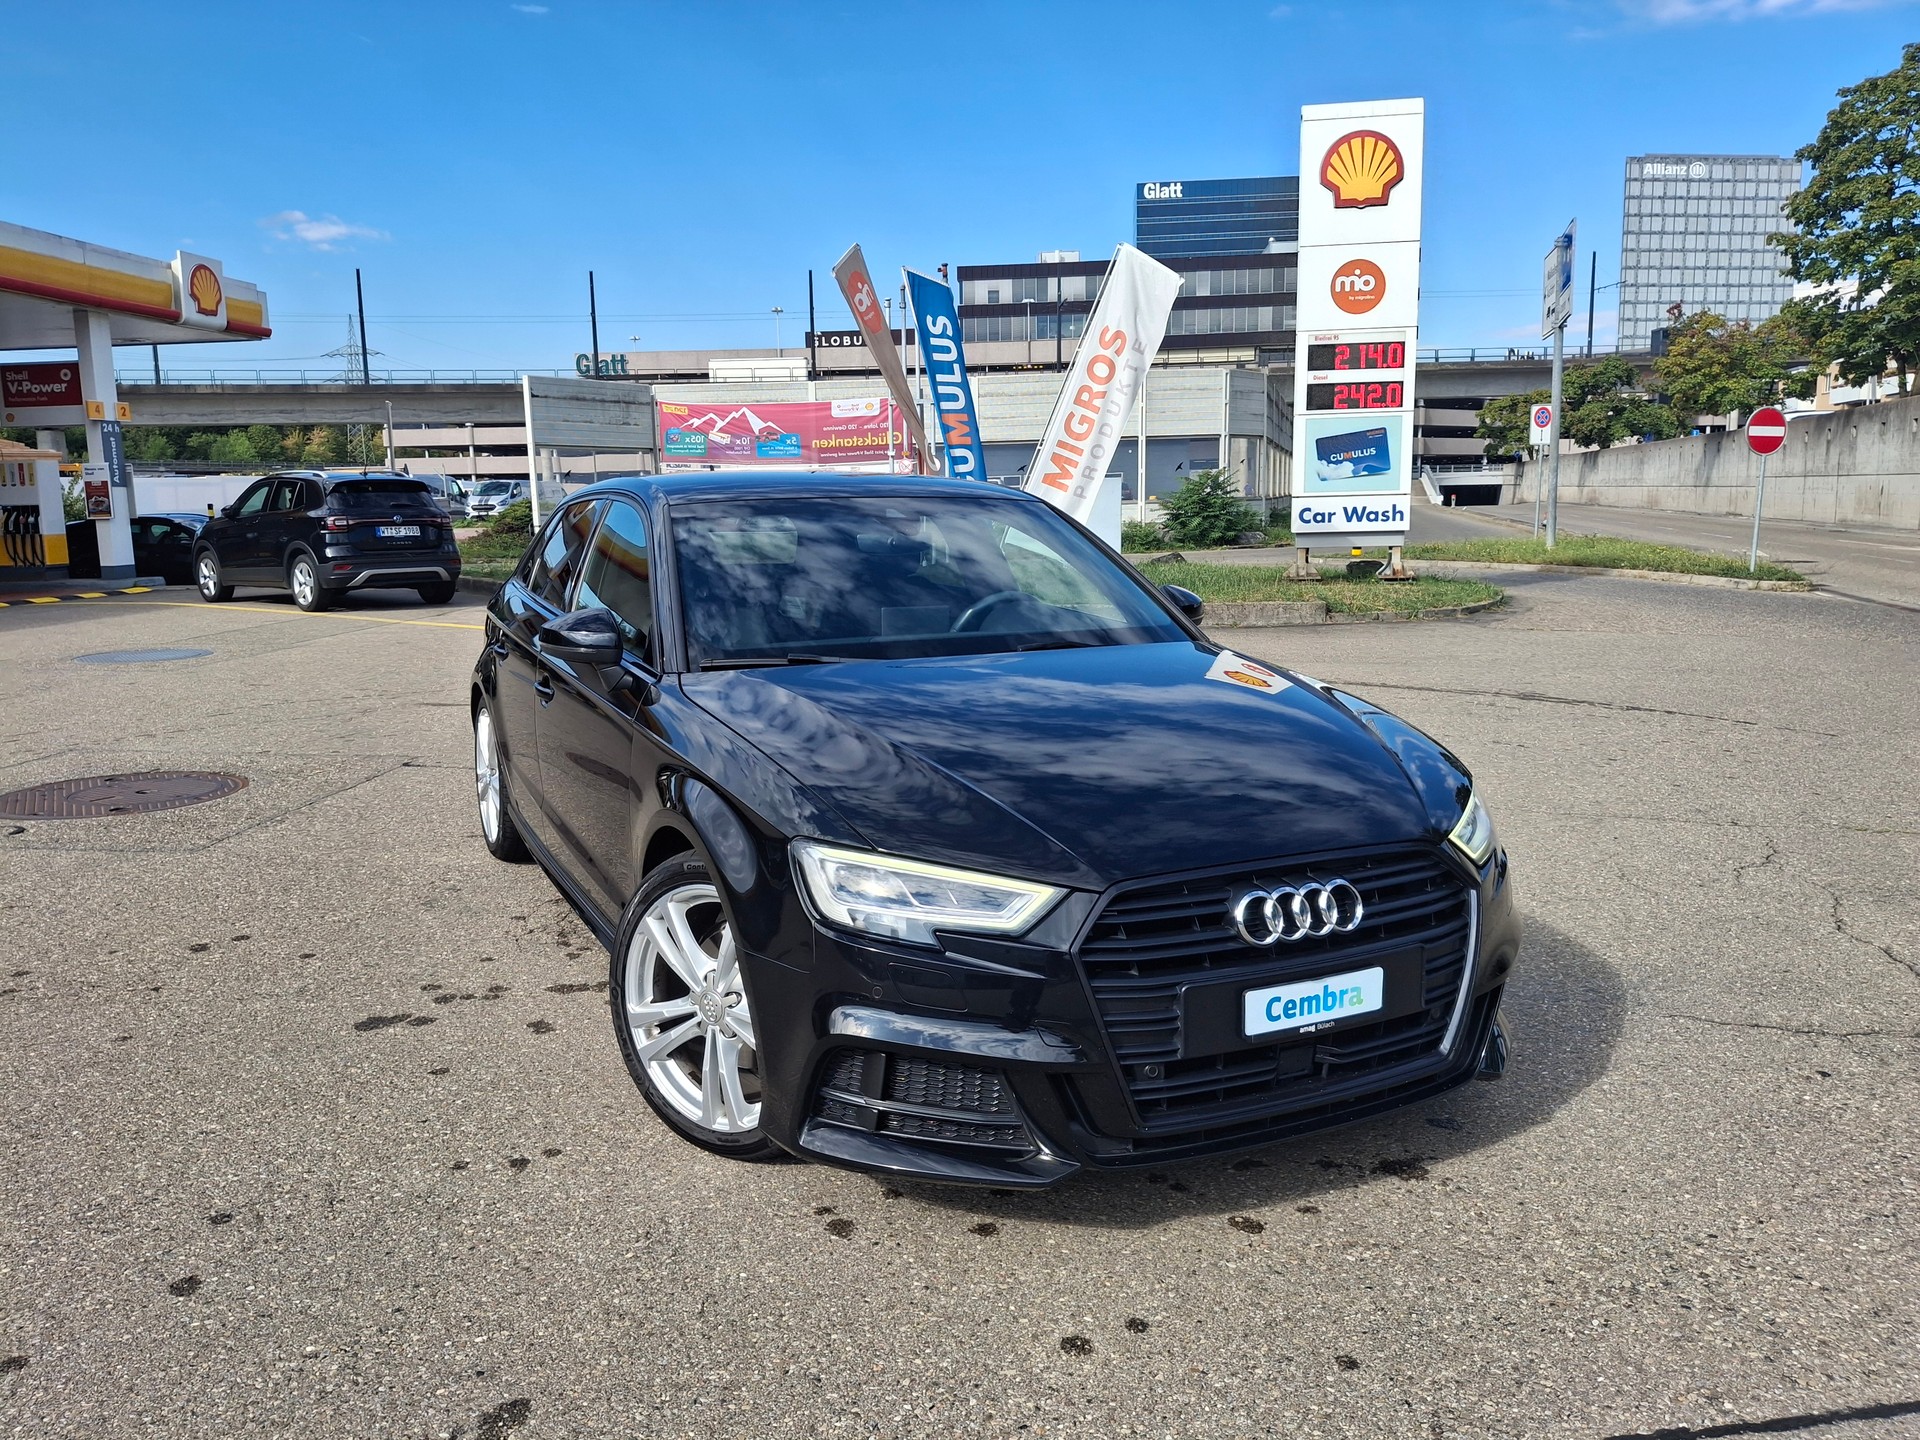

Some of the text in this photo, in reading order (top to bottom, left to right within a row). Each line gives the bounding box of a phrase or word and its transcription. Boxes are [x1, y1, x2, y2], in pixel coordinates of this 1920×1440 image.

[1643, 163, 1687, 175] Allianz
[1143, 182, 1183, 199] Glatt
[1335, 268, 1376, 293] mio
[814, 335, 863, 347] LOBU
[1335, 343, 1403, 370] 214.0
[6, 371, 28, 381] Shell
[7, 382, 67, 394] V-Power
[1333, 383, 1402, 409] 242.0
[94, 405, 101, 415] 4
[120, 406, 127, 416] 2
[1041, 325, 1128, 493] MIGROS
[1073, 337, 1148, 500] PRODUKTE
[103, 423, 120, 432] 24 h
[110, 437, 120, 483] Automat
[1330, 447, 1376, 462] CUMULUS
[1298, 504, 1404, 524] Car Wash
[1265, 985, 1363, 1022] Cembra
[1300, 1021, 1335, 1033] amag Bülach
